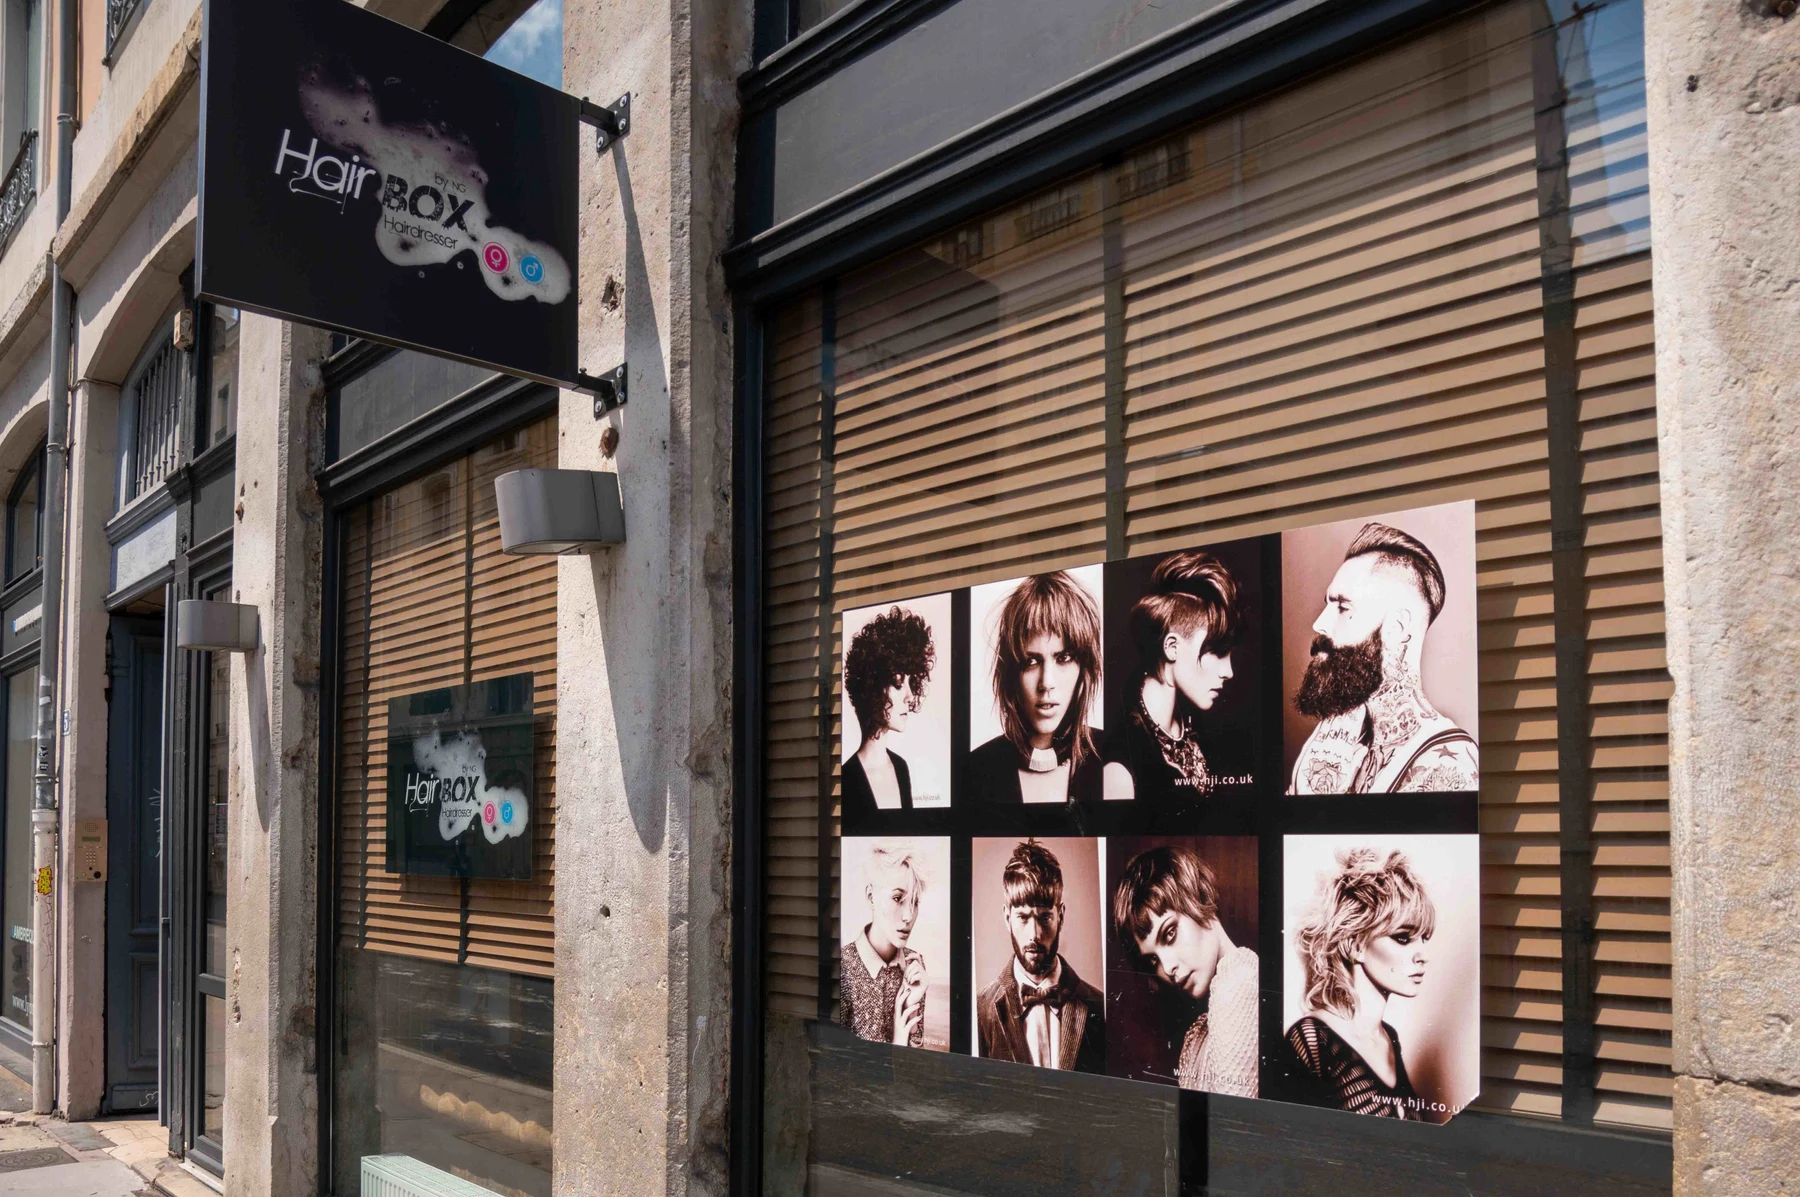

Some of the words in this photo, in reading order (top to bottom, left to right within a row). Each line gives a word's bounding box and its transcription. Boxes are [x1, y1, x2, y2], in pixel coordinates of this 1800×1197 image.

[275, 128, 377, 211] Hair
[382, 173, 475, 233] BOX
[434, 171, 449, 192] by
[452, 180, 467, 194] NG
[383, 215, 459, 250] Hairdresser
[404, 773, 440, 816] Hair
[441, 776, 480, 803] BOX
[441, 808, 472, 818] Hairdresser
